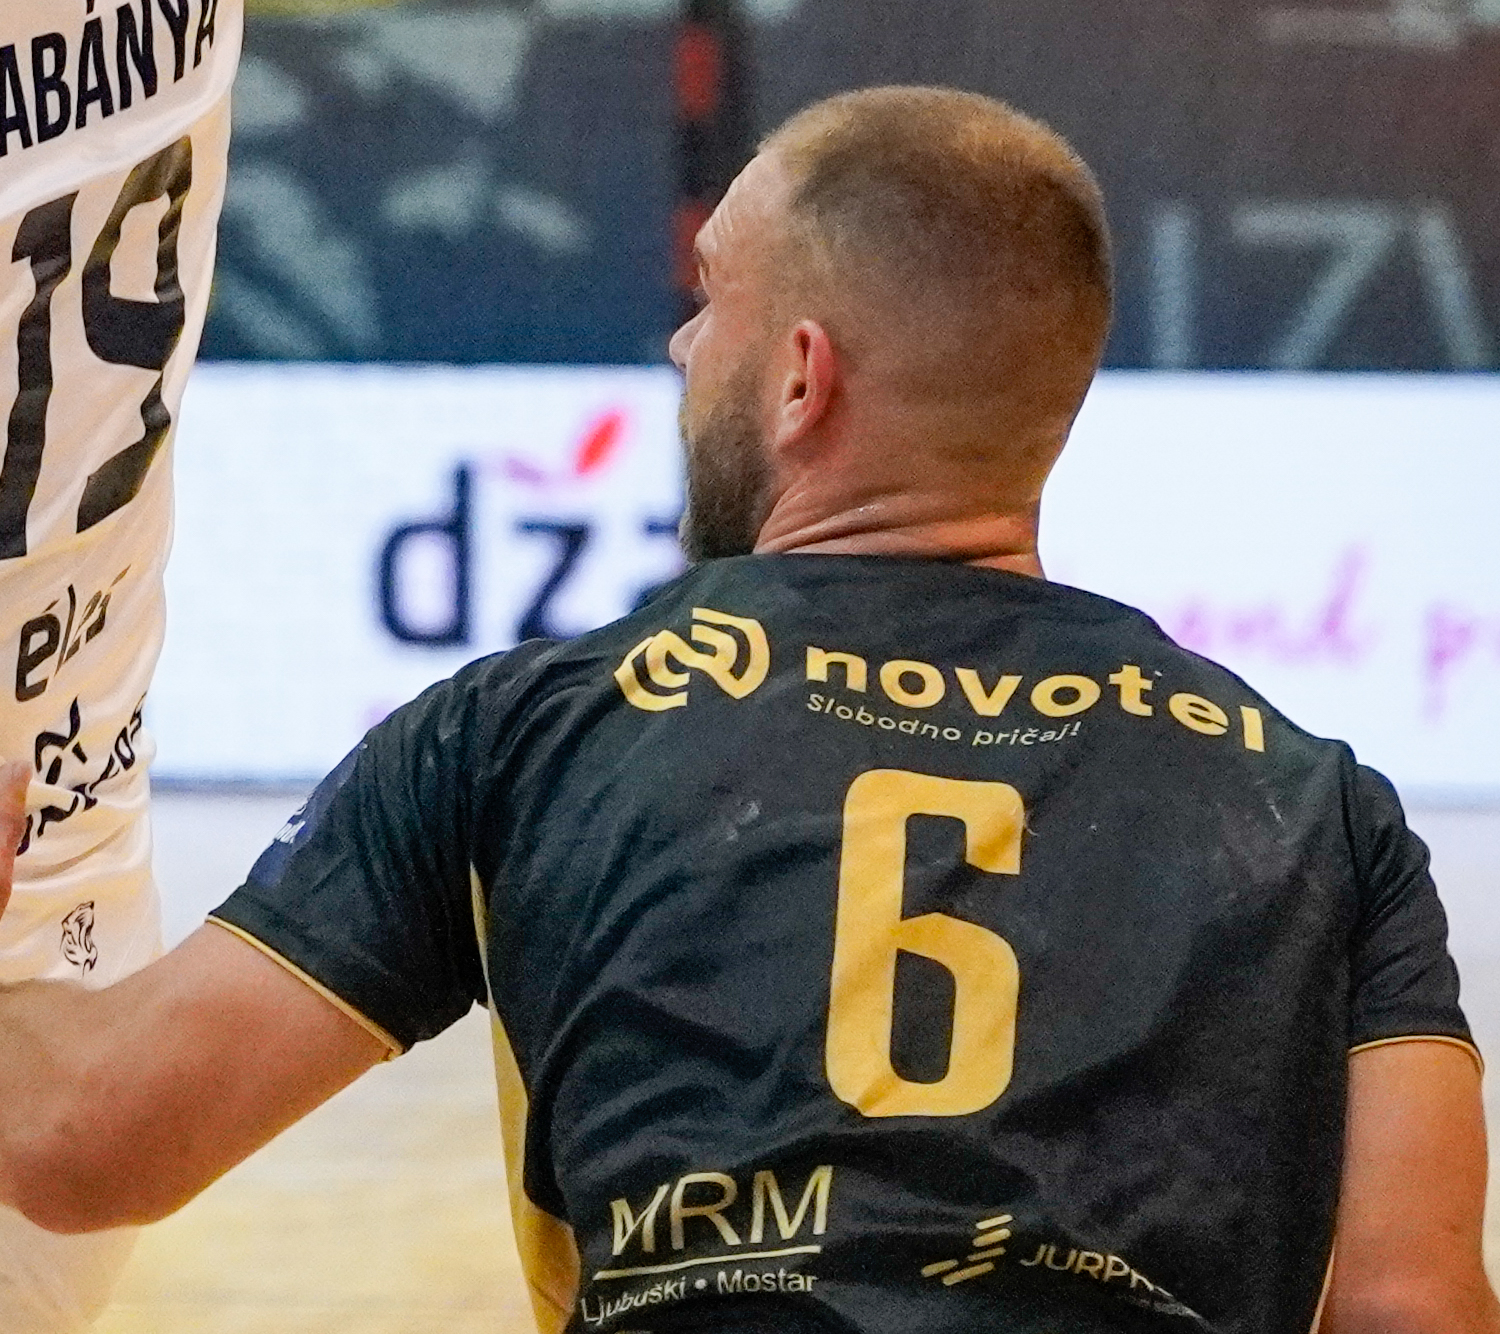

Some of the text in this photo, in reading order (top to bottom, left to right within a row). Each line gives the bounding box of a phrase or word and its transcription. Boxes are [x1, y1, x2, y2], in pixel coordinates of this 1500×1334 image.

[805, 645, 1266, 753] novotel
[807, 693, 1081, 748] Slobodno pričaj!
[826, 769, 1025, 1118] 6
[609, 1165, 833, 1257] MRM
[580, 1269, 818, 1327] Ljubuški Mostar
